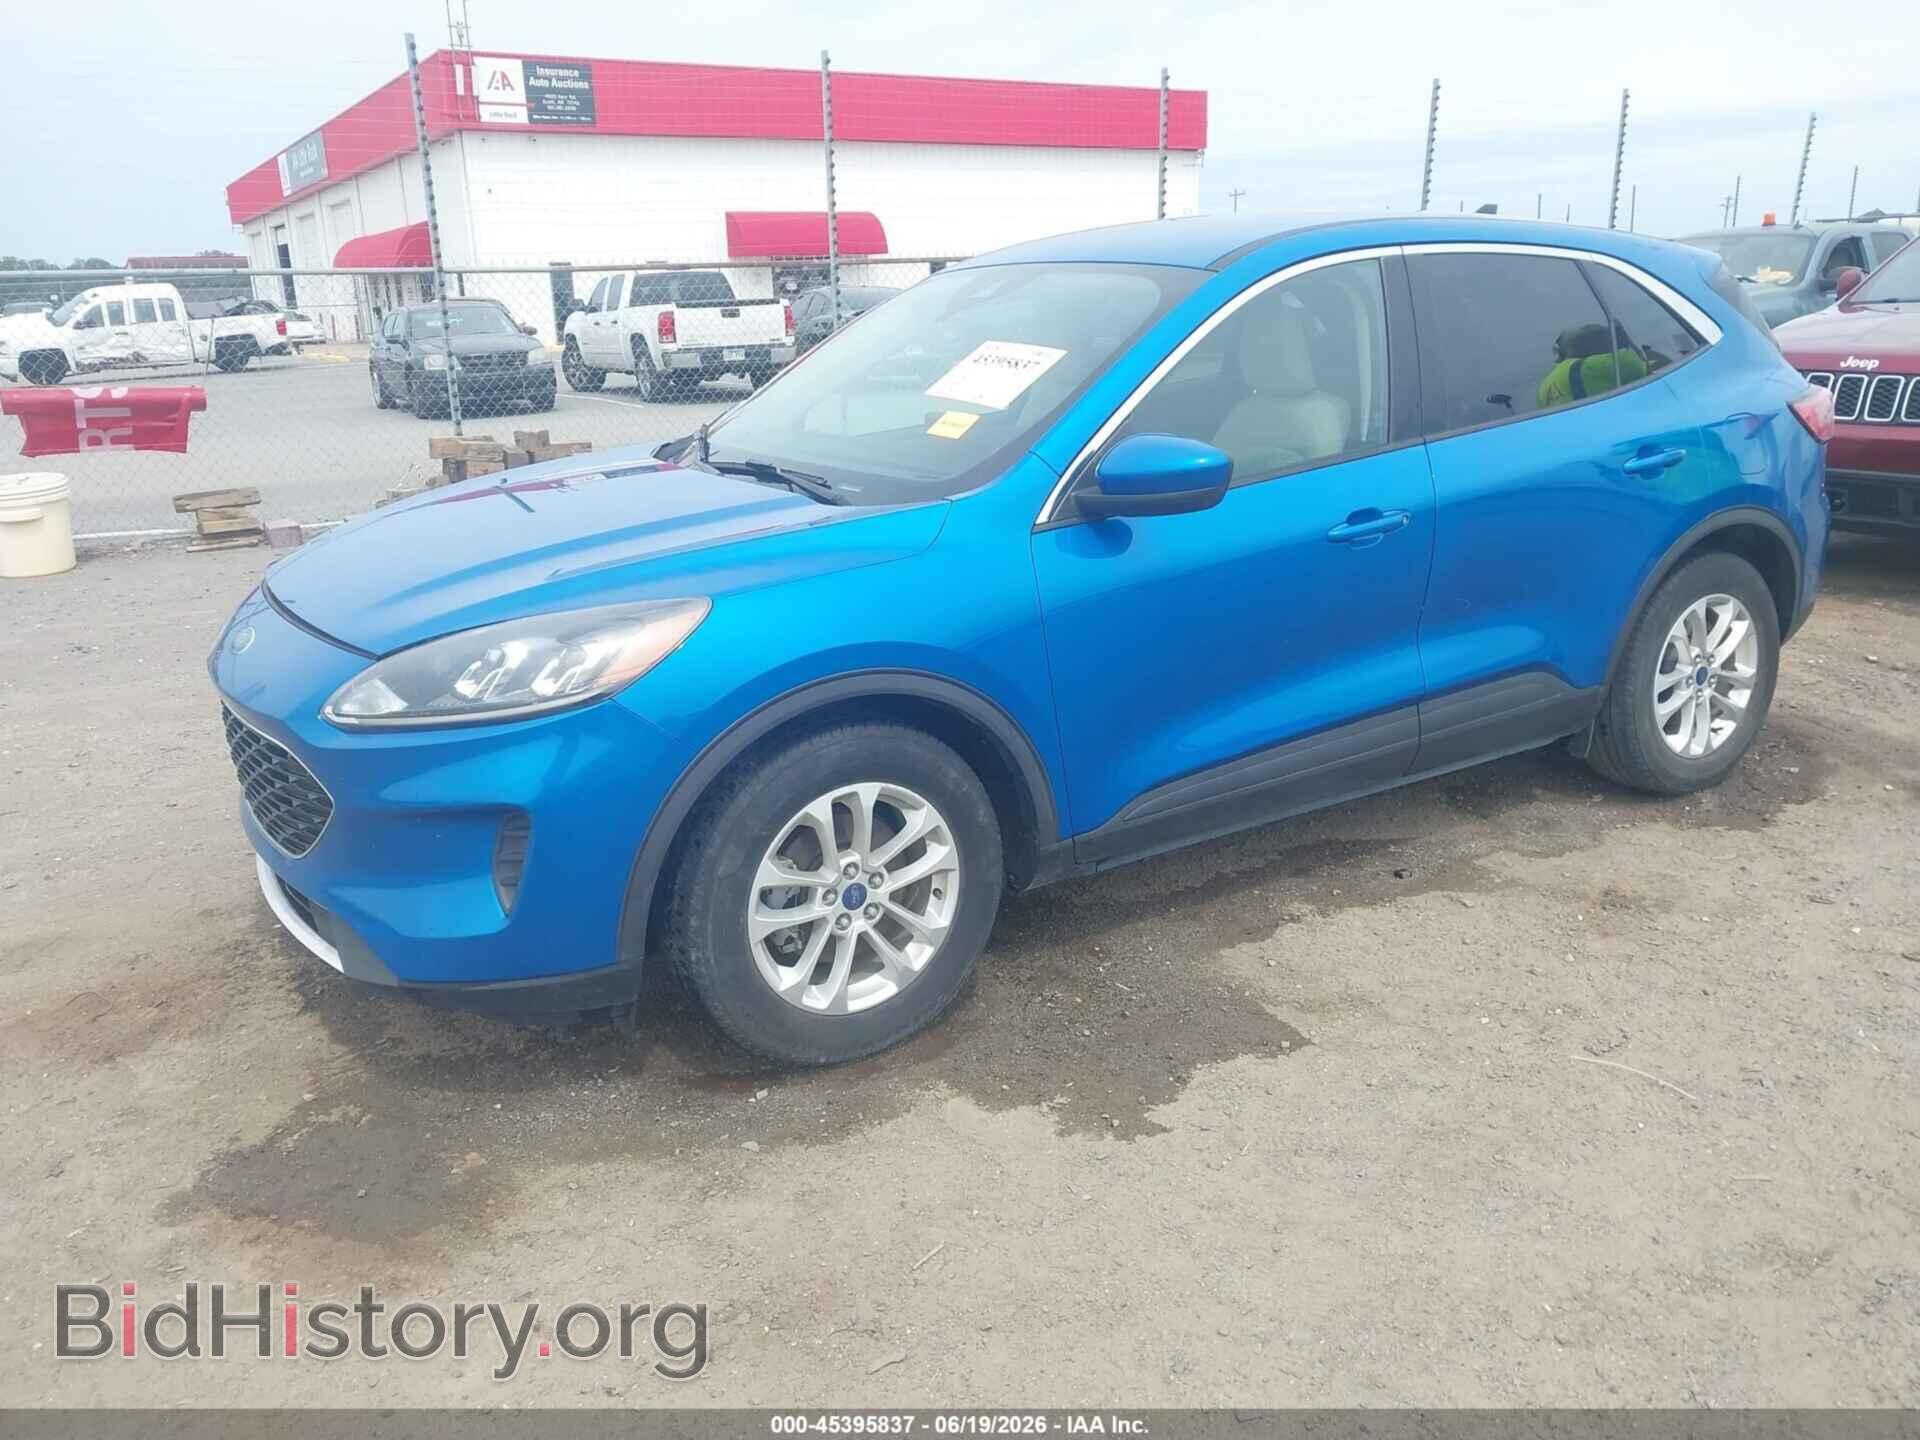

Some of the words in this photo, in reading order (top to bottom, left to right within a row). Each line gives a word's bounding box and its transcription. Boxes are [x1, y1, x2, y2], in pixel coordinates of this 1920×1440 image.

[535, 65, 579, 77] Insurance
[528, 76, 549, 87] Auto
[551, 78, 589, 89] Auctions
[1840, 355, 1880, 371] Jeep
